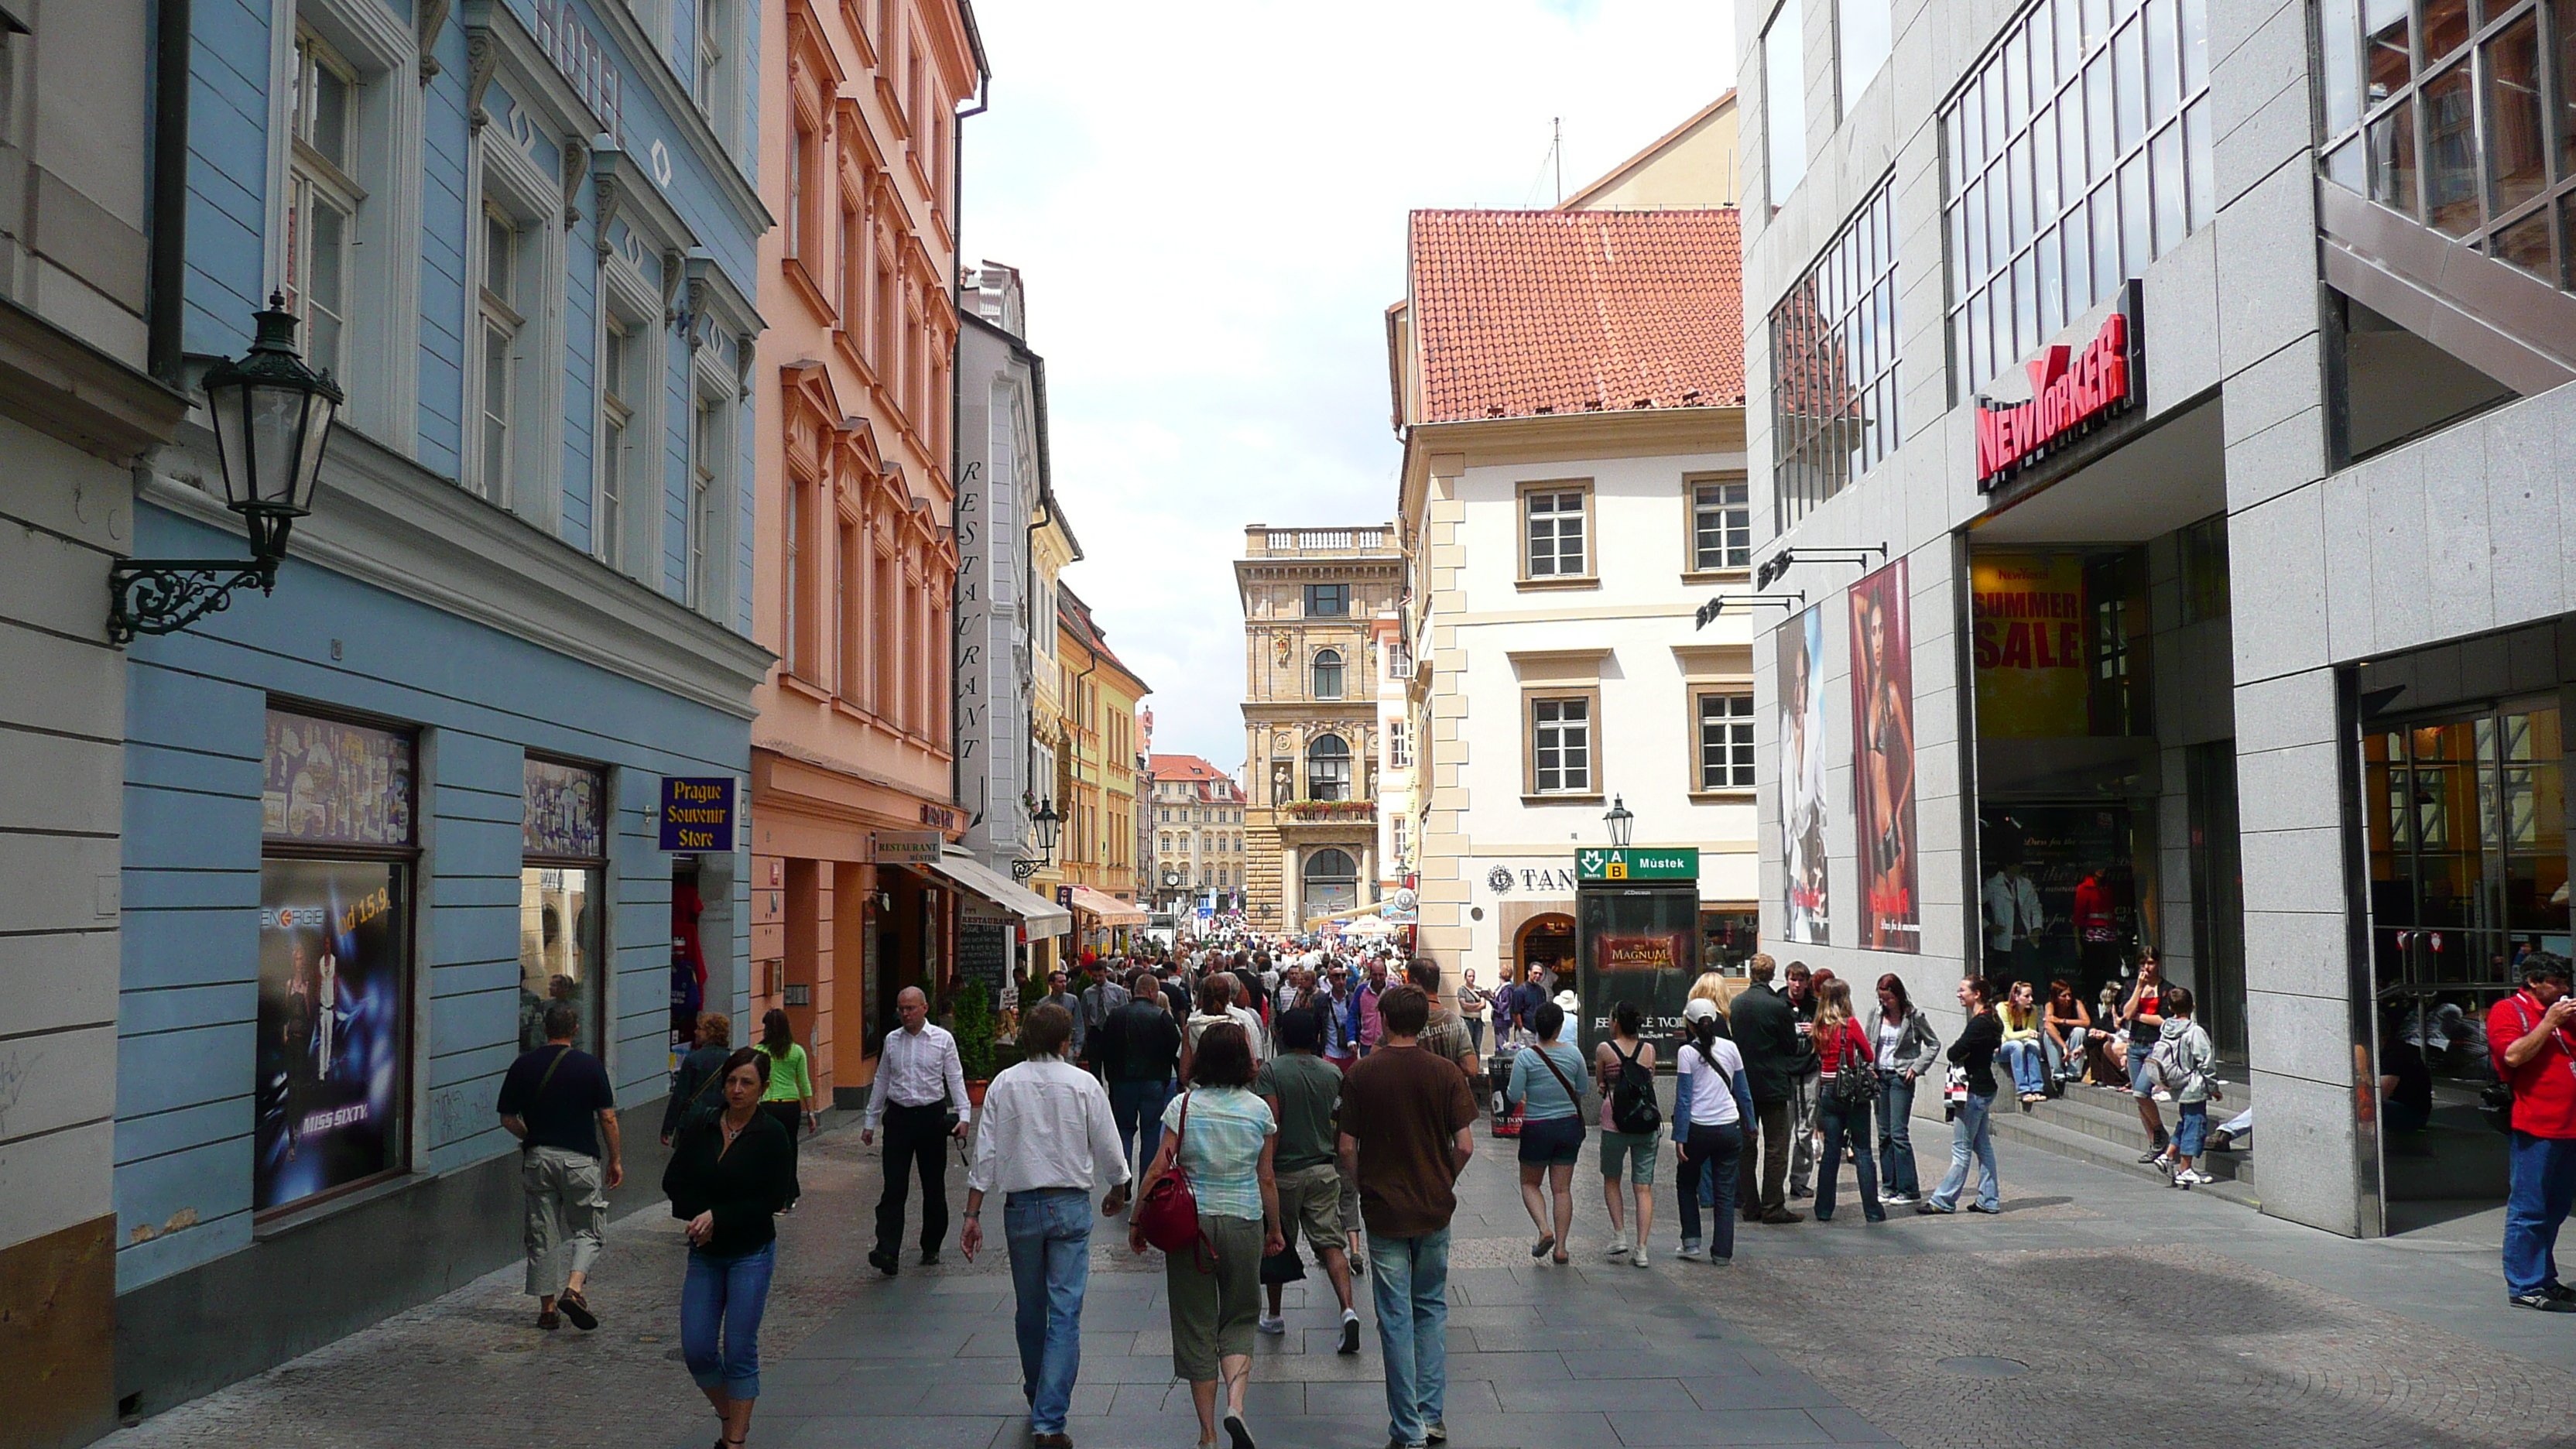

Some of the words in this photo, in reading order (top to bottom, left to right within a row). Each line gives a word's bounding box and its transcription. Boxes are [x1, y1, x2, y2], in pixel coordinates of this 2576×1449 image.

[958, 461, 986, 759] RESTAURANT
[1972, 592, 2078, 618] SUMMER
[1974, 622, 2080, 670] SALE
[674, 781, 722, 803] Prague
[667, 805, 727, 824] Souvenir
[678, 828, 714, 847] Store
[879, 843, 937, 851] RESTAURANT
[1611, 851, 1622, 862] A
[1612, 866, 1622, 878] B
[338, 904, 356, 936] od
[358, 887, 391, 923] 15.9.
[961, 916, 1016, 926] RESTAURANT
[1612, 949, 1668, 960] MAGNUM
[302, 1112, 334, 1135] MISS
[334, 1104, 368, 1126] SIXTY
